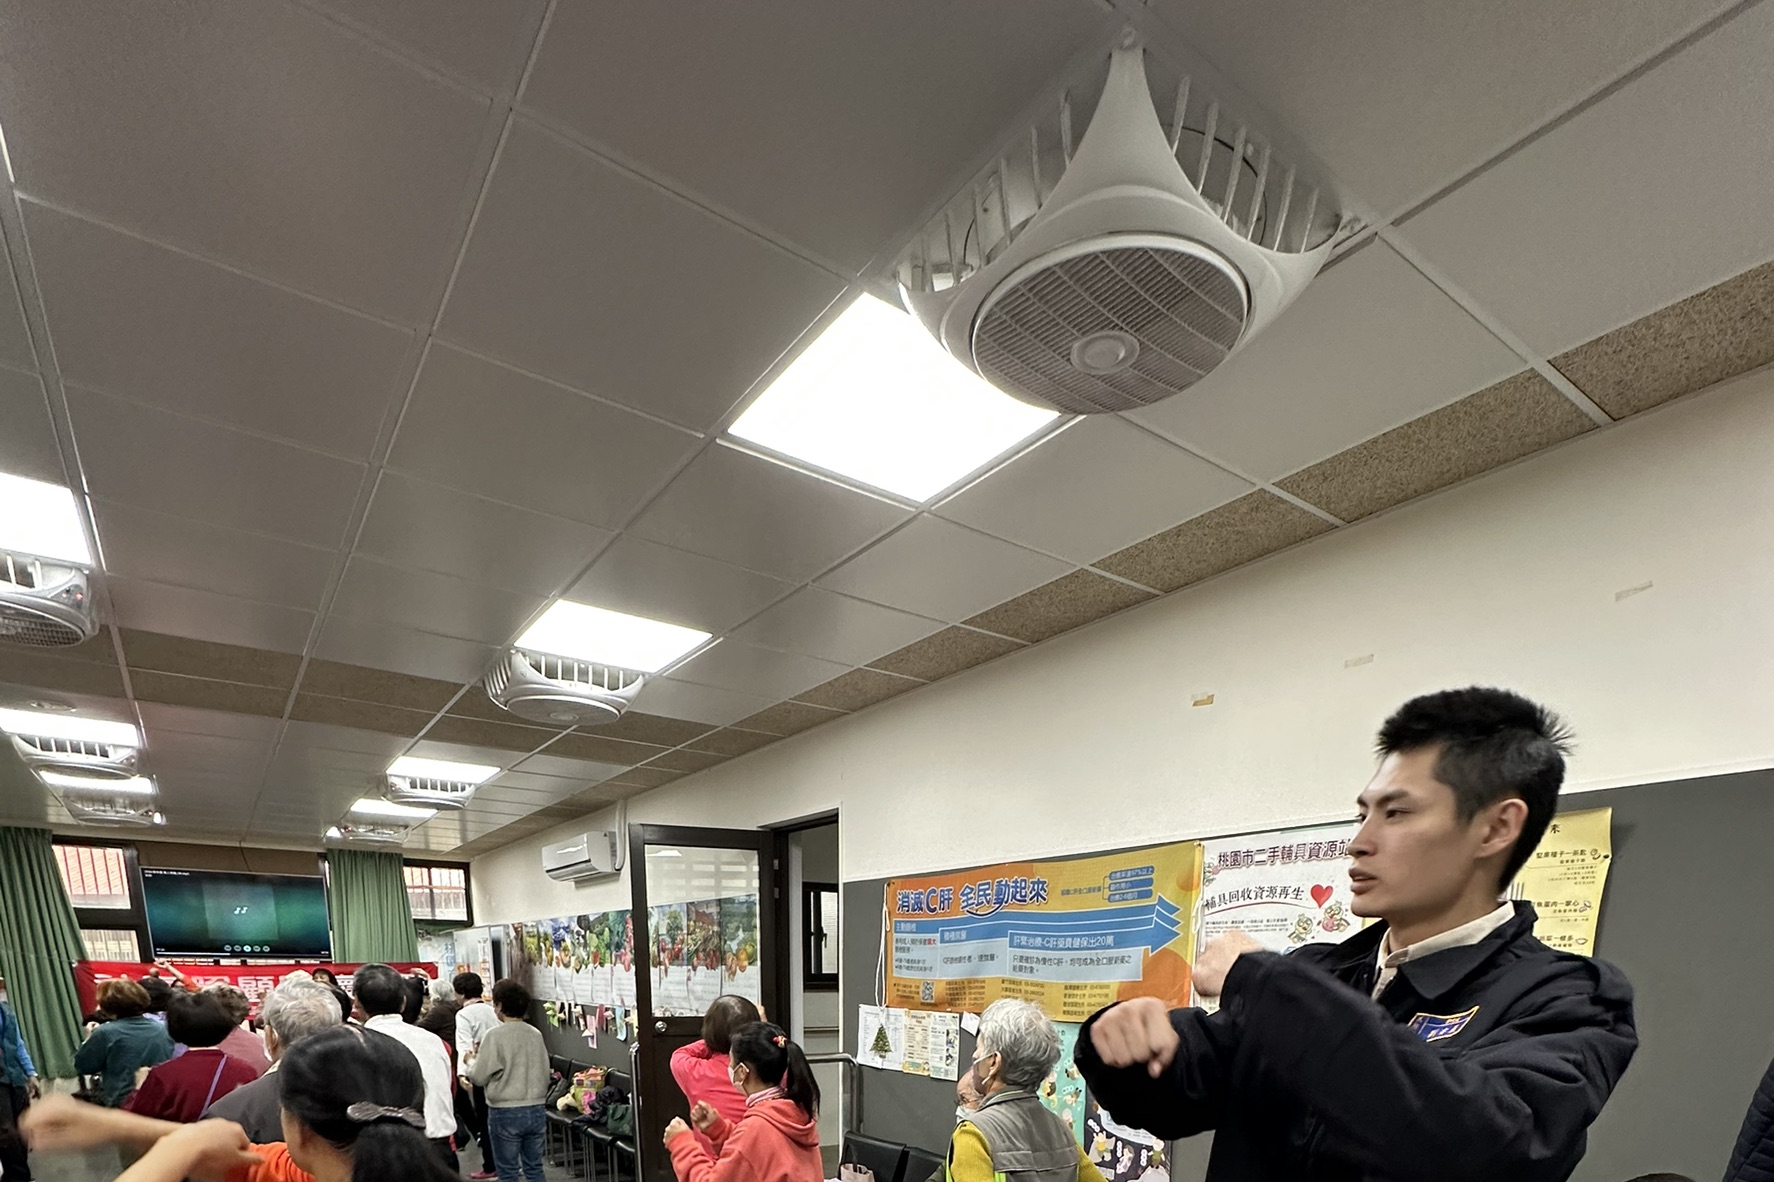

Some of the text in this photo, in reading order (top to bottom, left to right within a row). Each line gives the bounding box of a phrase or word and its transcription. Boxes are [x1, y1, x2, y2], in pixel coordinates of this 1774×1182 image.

[896, 877, 1048, 914] 消滅C肝 全民動起來
